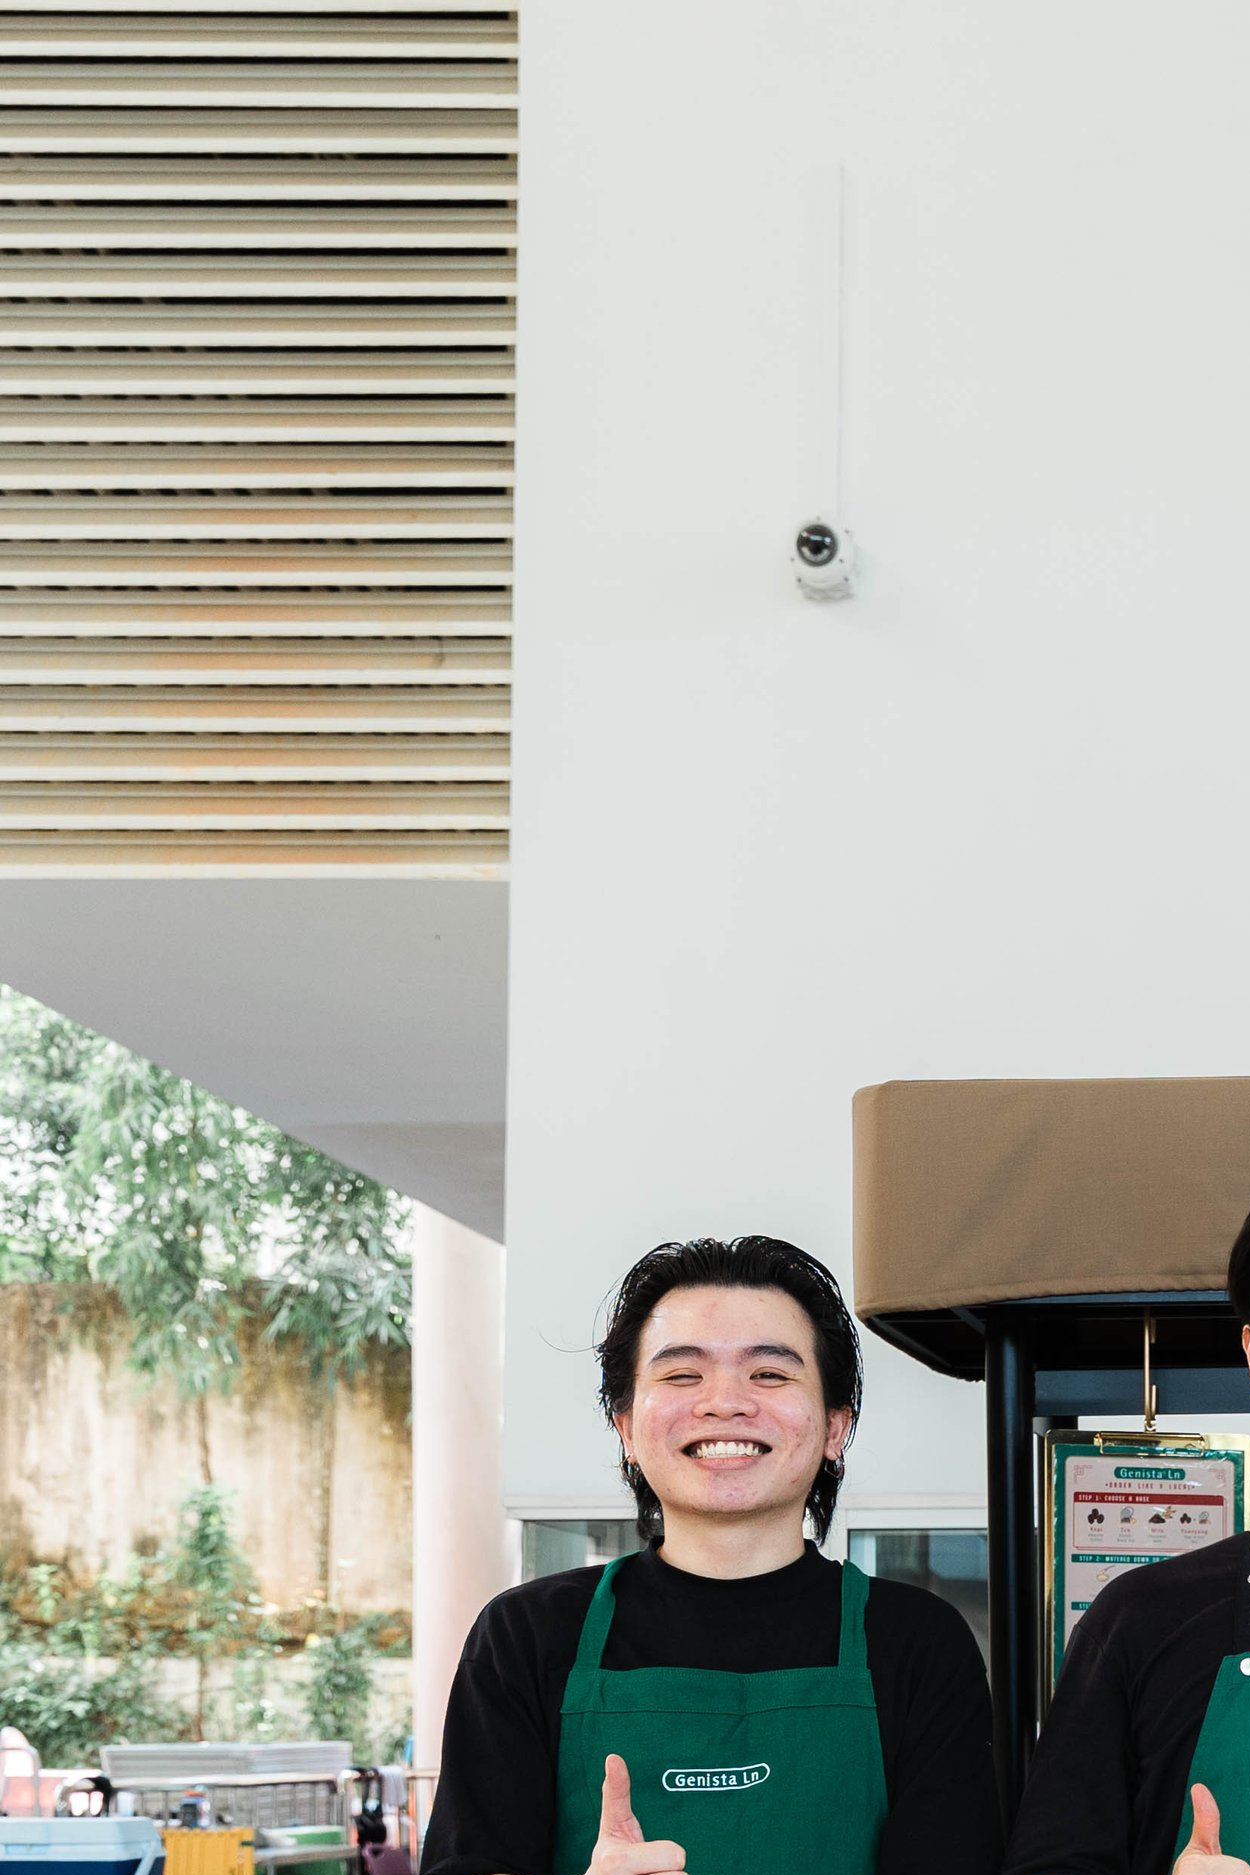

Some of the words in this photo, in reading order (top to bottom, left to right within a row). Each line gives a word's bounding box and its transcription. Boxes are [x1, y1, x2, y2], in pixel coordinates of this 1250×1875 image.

[1119, 1468, 1163, 1479] Genista
[1168, 1469, 1181, 1479] Ln
[675, 1773, 738, 1787] Genista
[743, 1770, 759, 1784] Ln
